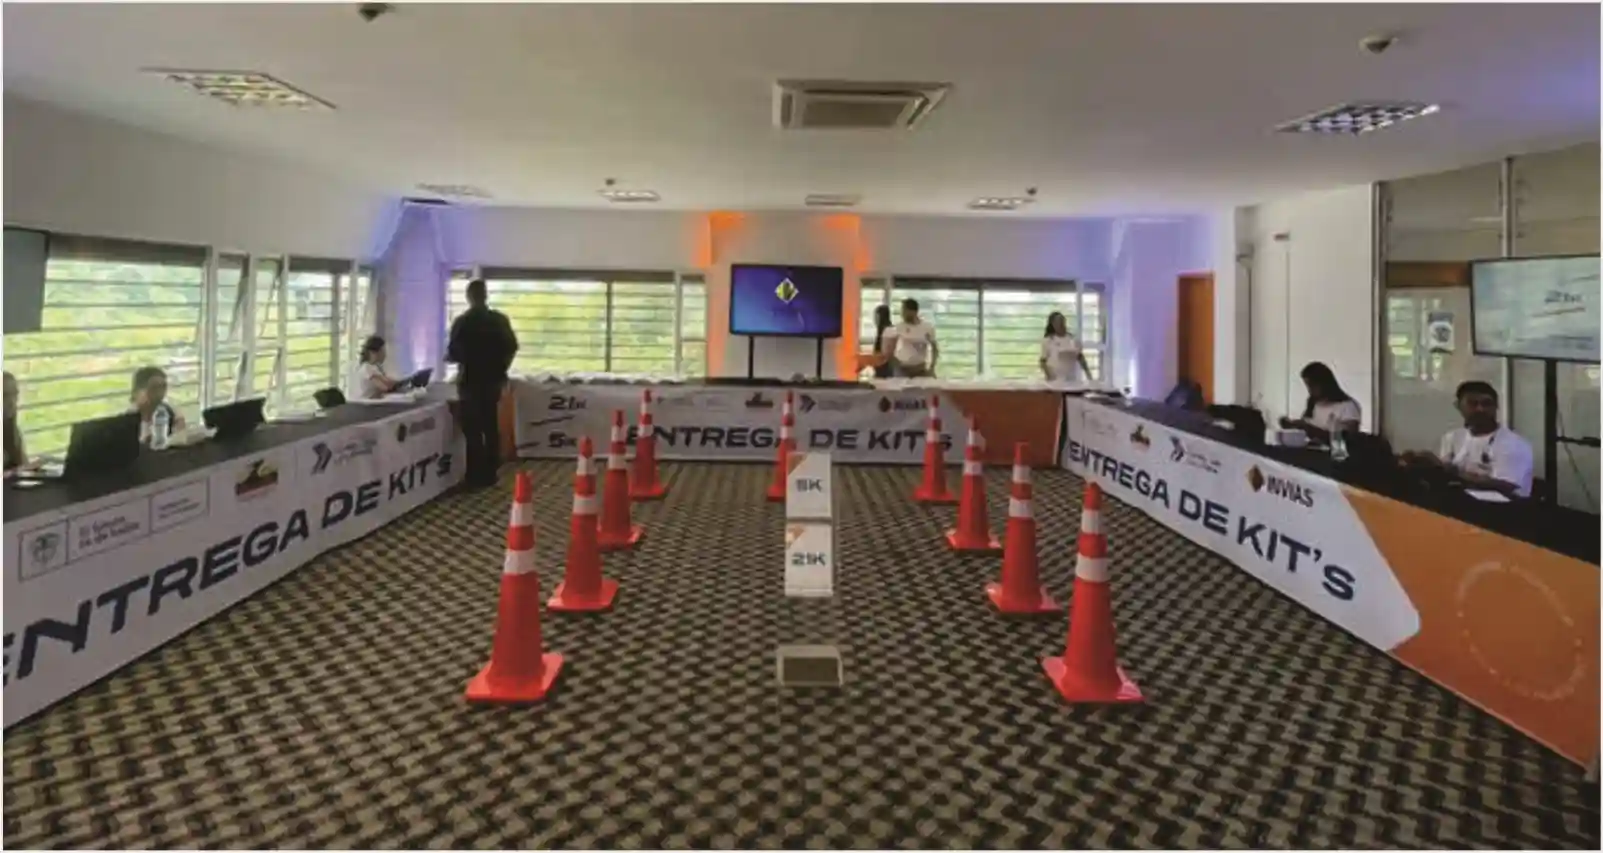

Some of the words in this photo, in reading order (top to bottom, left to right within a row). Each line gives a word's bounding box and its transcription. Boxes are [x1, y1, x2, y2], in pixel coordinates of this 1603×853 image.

[809, 429, 858, 449] DE
[1069, 441, 1170, 502] ENTREGA
[1179, 489, 1230, 536] DE
[1237, 515, 1356, 601] KIT'S
[1267, 474, 1315, 508] INVIAS
[3, 509, 310, 688] NTREGA
[321, 480, 383, 529] DE
